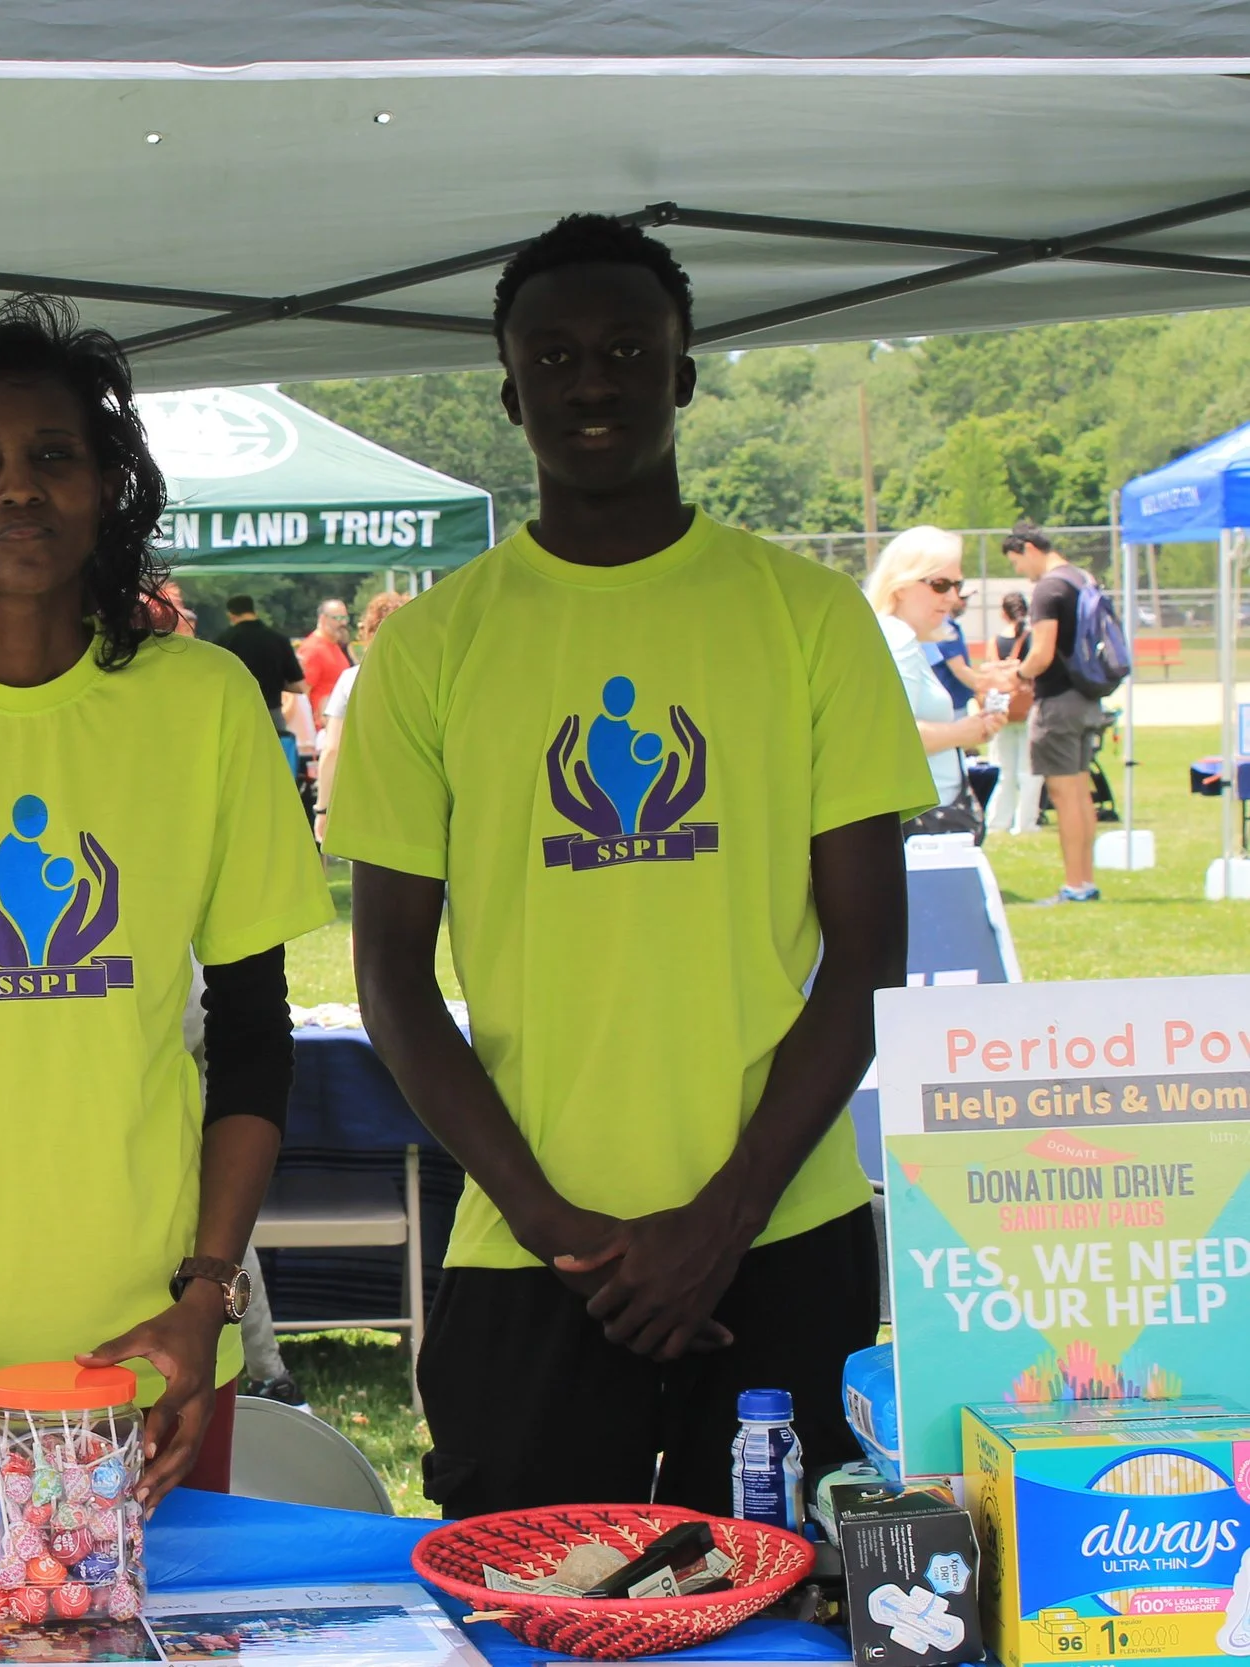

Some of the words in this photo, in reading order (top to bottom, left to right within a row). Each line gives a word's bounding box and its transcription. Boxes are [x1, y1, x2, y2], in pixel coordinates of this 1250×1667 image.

[211, 511, 309, 549] LAND
[319, 510, 441, 548] TRUST
[597, 839, 667, 862] SSPI
[946, 1022, 1136, 1074] Period
[934, 1088, 1017, 1125] Help
[1028, 1084, 1112, 1117] Girls
[1120, 1085, 1148, 1113] &
[1156, 1083, 1250, 1112] Wom
[1046, 1139, 1100, 1160] DONATE
[967, 1167, 1104, 1204] DONATION
[1113, 1163, 1195, 1198] DRIVE
[999, 1203, 1101, 1233] SANITARY
[1107, 1201, 1165, 1228] PADS
[909, 1247, 1021, 1295] YES,
[1032, 1242, 1115, 1284] WE
[1129, 1237, 1250, 1281] NEED
[944, 1289, 1093, 1333] YOUR
[1106, 1283, 1228, 1326] HELP
[1081, 1508, 1241, 1569] always
[950, 1558, 961, 1586] Xpress
[1102, 1559, 1150, 1573] ULTRA
[1152, 1557, 1188, 1570] THIN
[305, 1590, 373, 1603] Project
[1134, 1599, 1174, 1613] 100%
[1174, 1597, 1221, 1606] LEAK-FREE
[1174, 1604, 1218, 1612] COMFORT
[872, 1647, 885, 1658] U
[1057, 1635, 1084, 1652] 96
[1100, 1620, 1115, 1655] 1
